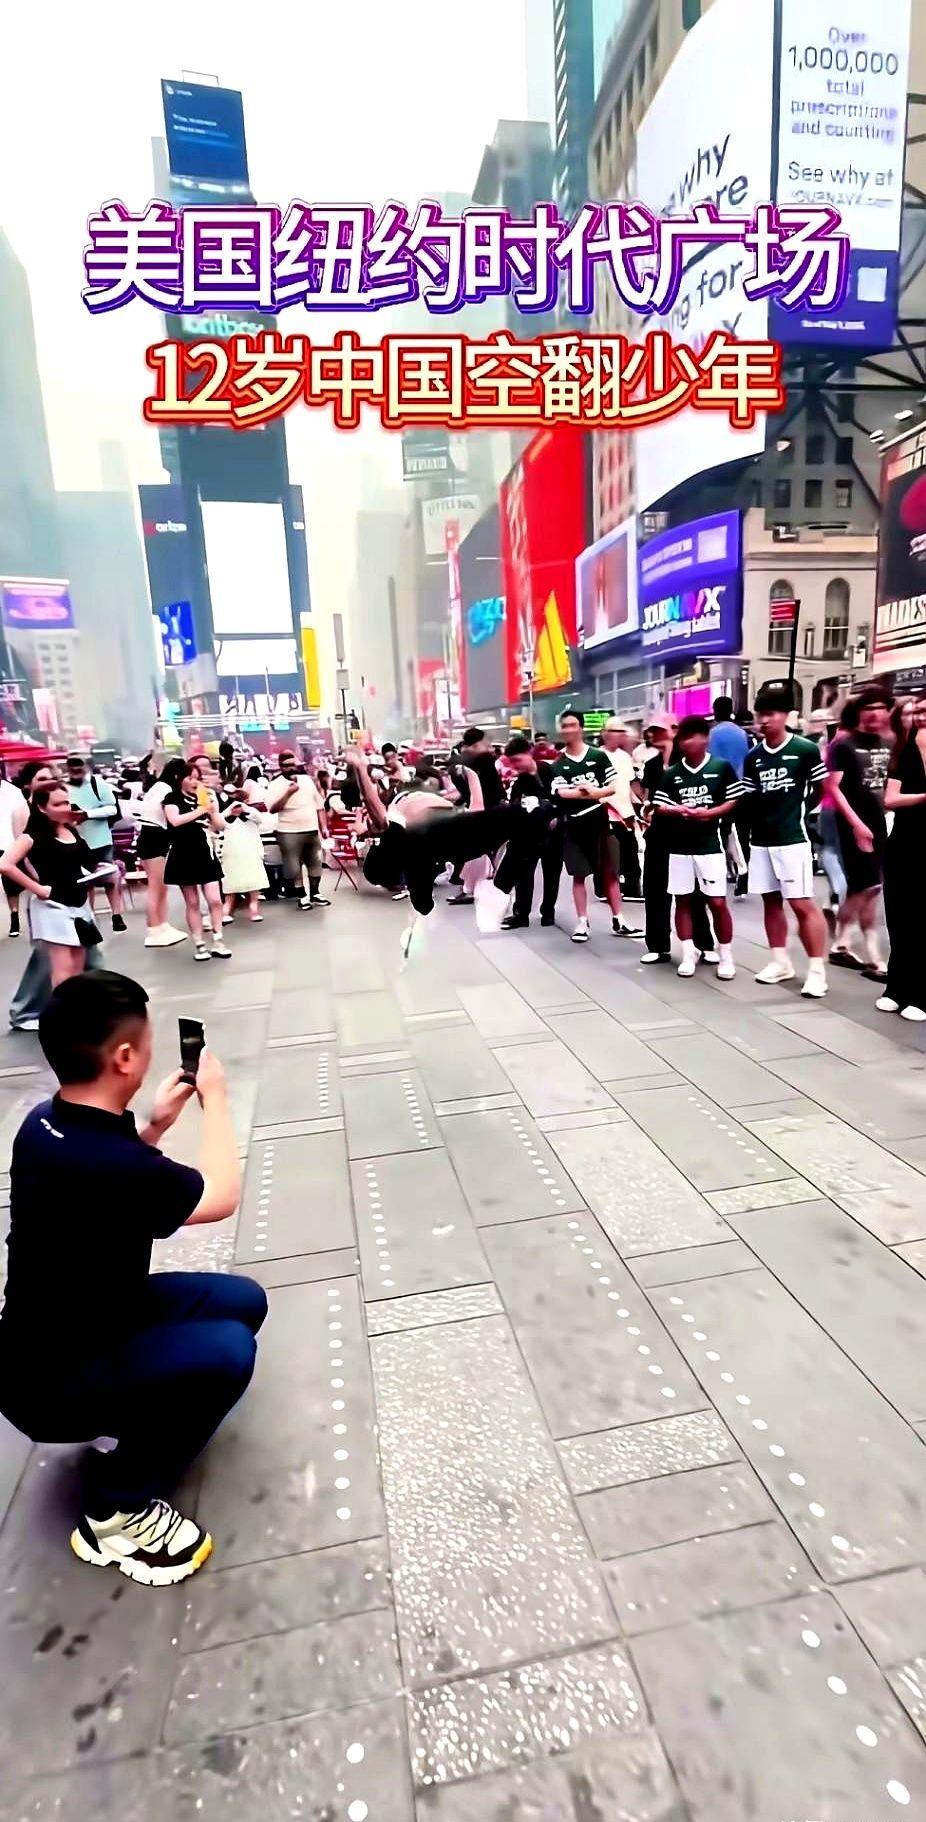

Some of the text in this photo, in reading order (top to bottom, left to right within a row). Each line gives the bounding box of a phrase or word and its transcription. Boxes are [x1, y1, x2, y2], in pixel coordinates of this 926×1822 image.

[828, 27, 867, 43] Over
[788, 45, 899, 75] 1,000,000
[827, 79, 864, 96] total
[792, 119, 820, 136] and
[679, 134, 730, 203] why
[788, 161, 894, 191] See why at
[697, 260, 743, 308] for
